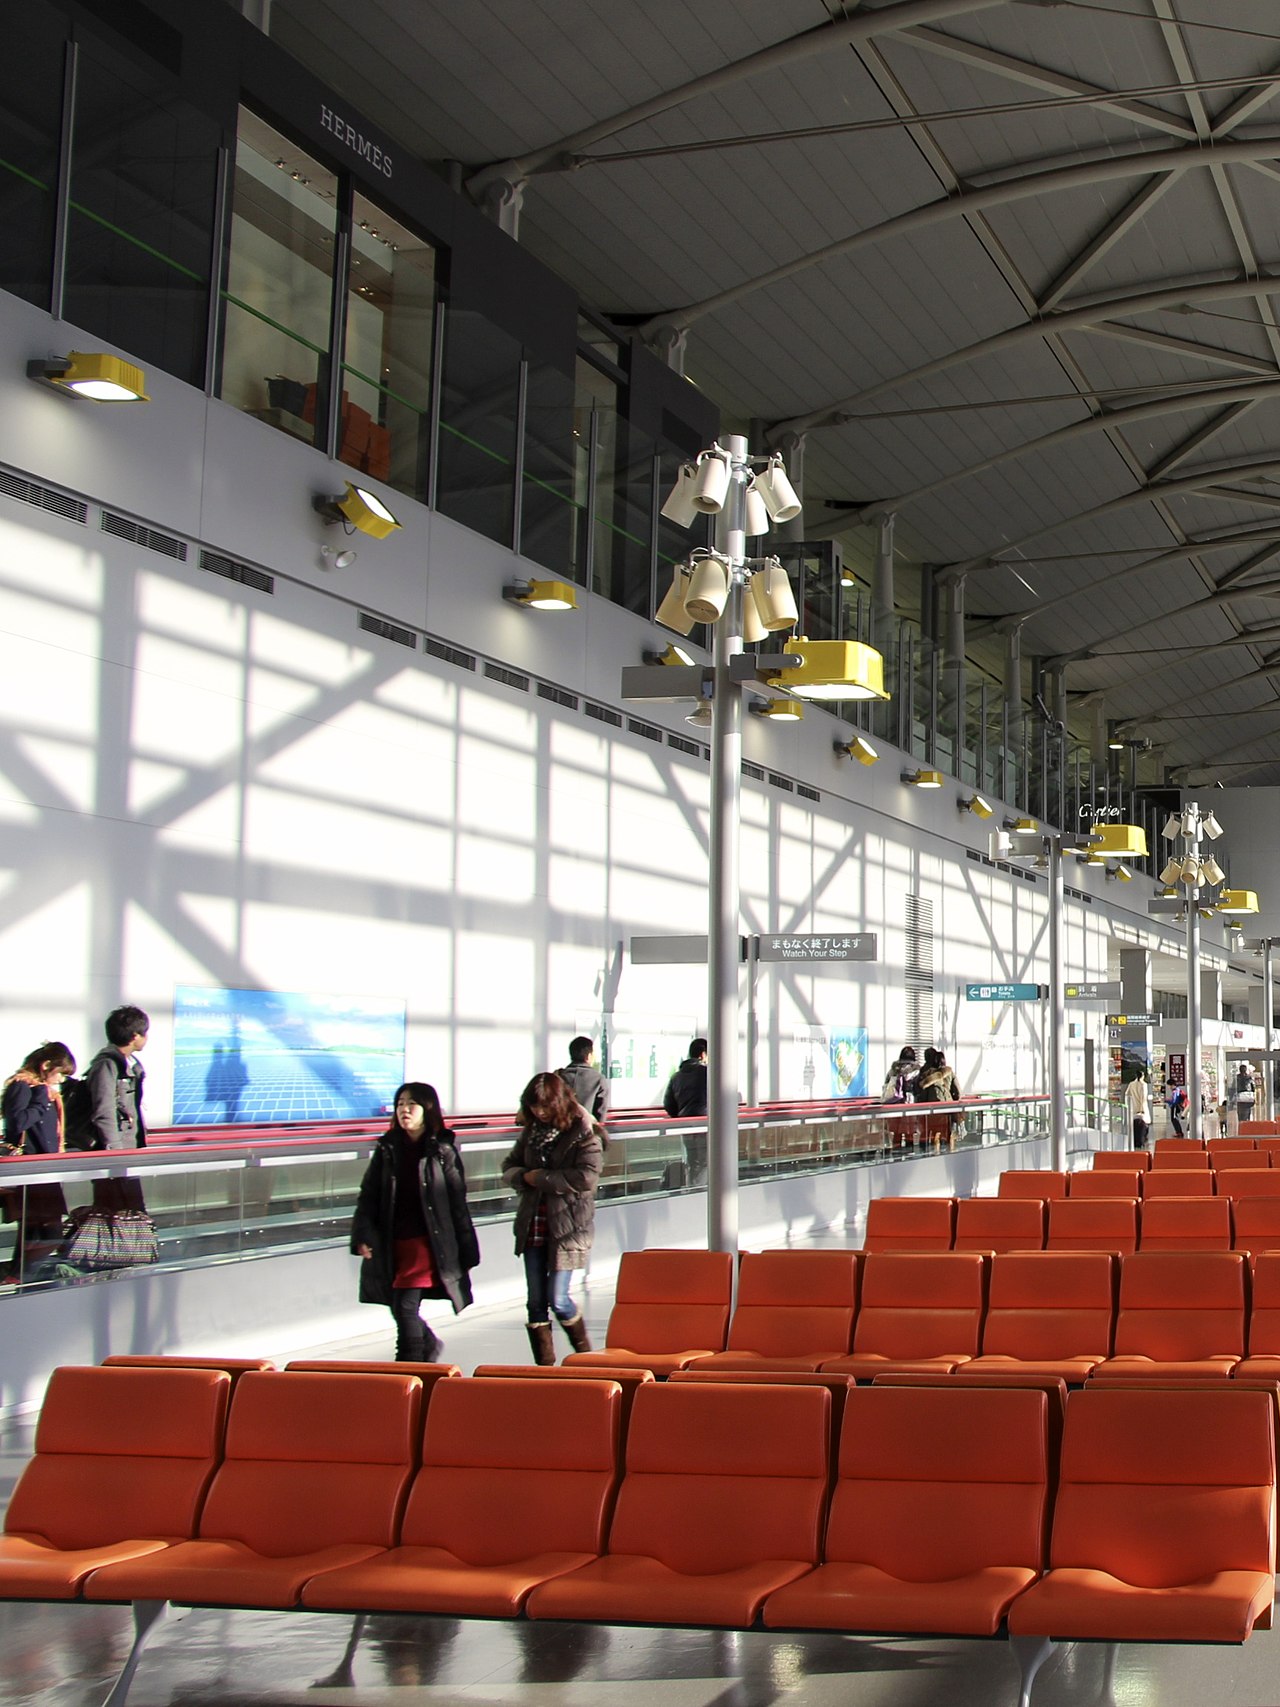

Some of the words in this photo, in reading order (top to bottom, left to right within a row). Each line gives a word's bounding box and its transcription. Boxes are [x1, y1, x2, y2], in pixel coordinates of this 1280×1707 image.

[320, 104, 392, 178] HERMÈS
[772, 938, 861, 949] まもなく終了します
[782, 949, 807, 958] Watch
[808, 949, 827, 958] Your
[828, 948, 848, 959] Step
